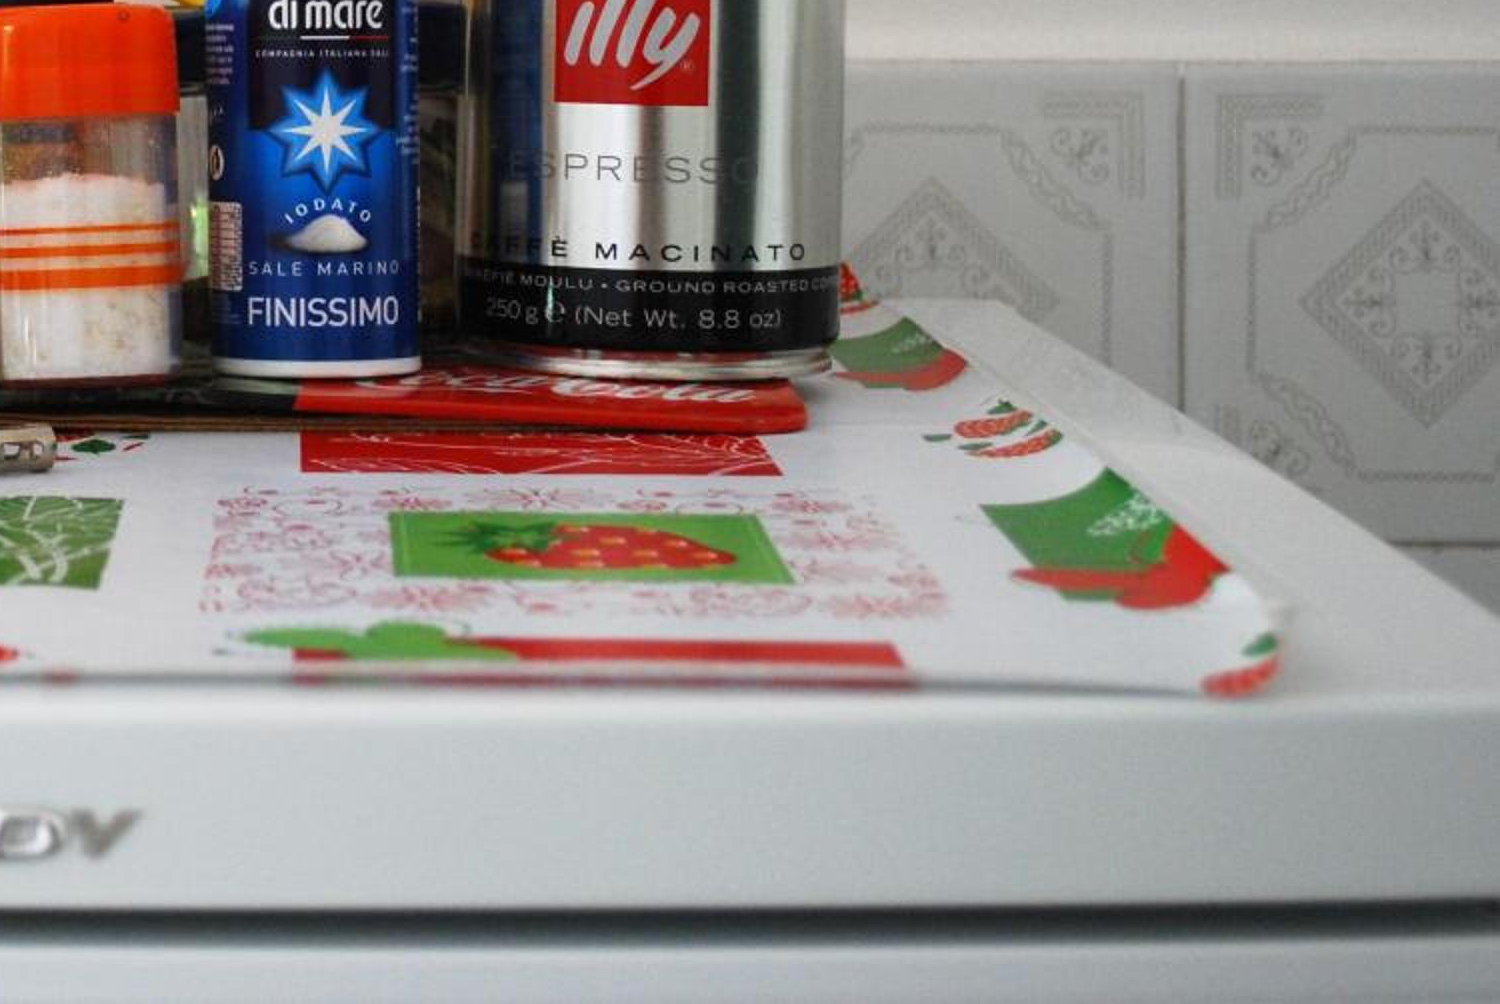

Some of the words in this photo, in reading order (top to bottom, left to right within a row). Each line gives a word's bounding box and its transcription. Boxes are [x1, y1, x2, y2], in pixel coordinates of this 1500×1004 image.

[305, 0, 384, 30] mare
[284, 198, 372, 224] IODATO
[596, 243, 805, 263] MACINATO
[250, 261, 303, 277] SALE
[317, 260, 400, 277] MARINO
[519, 275, 594, 292] MOULU
[615, 280, 716, 294] GROUND
[723, 279, 809, 294] ROASTED
[248, 297, 399, 327] FINISSIMO
[575, 306, 632, 328] (Net
[644, 308, 686, 329] Wt.
[699, 308, 740, 330] 8.8
[749, 308, 782, 329] oz)
